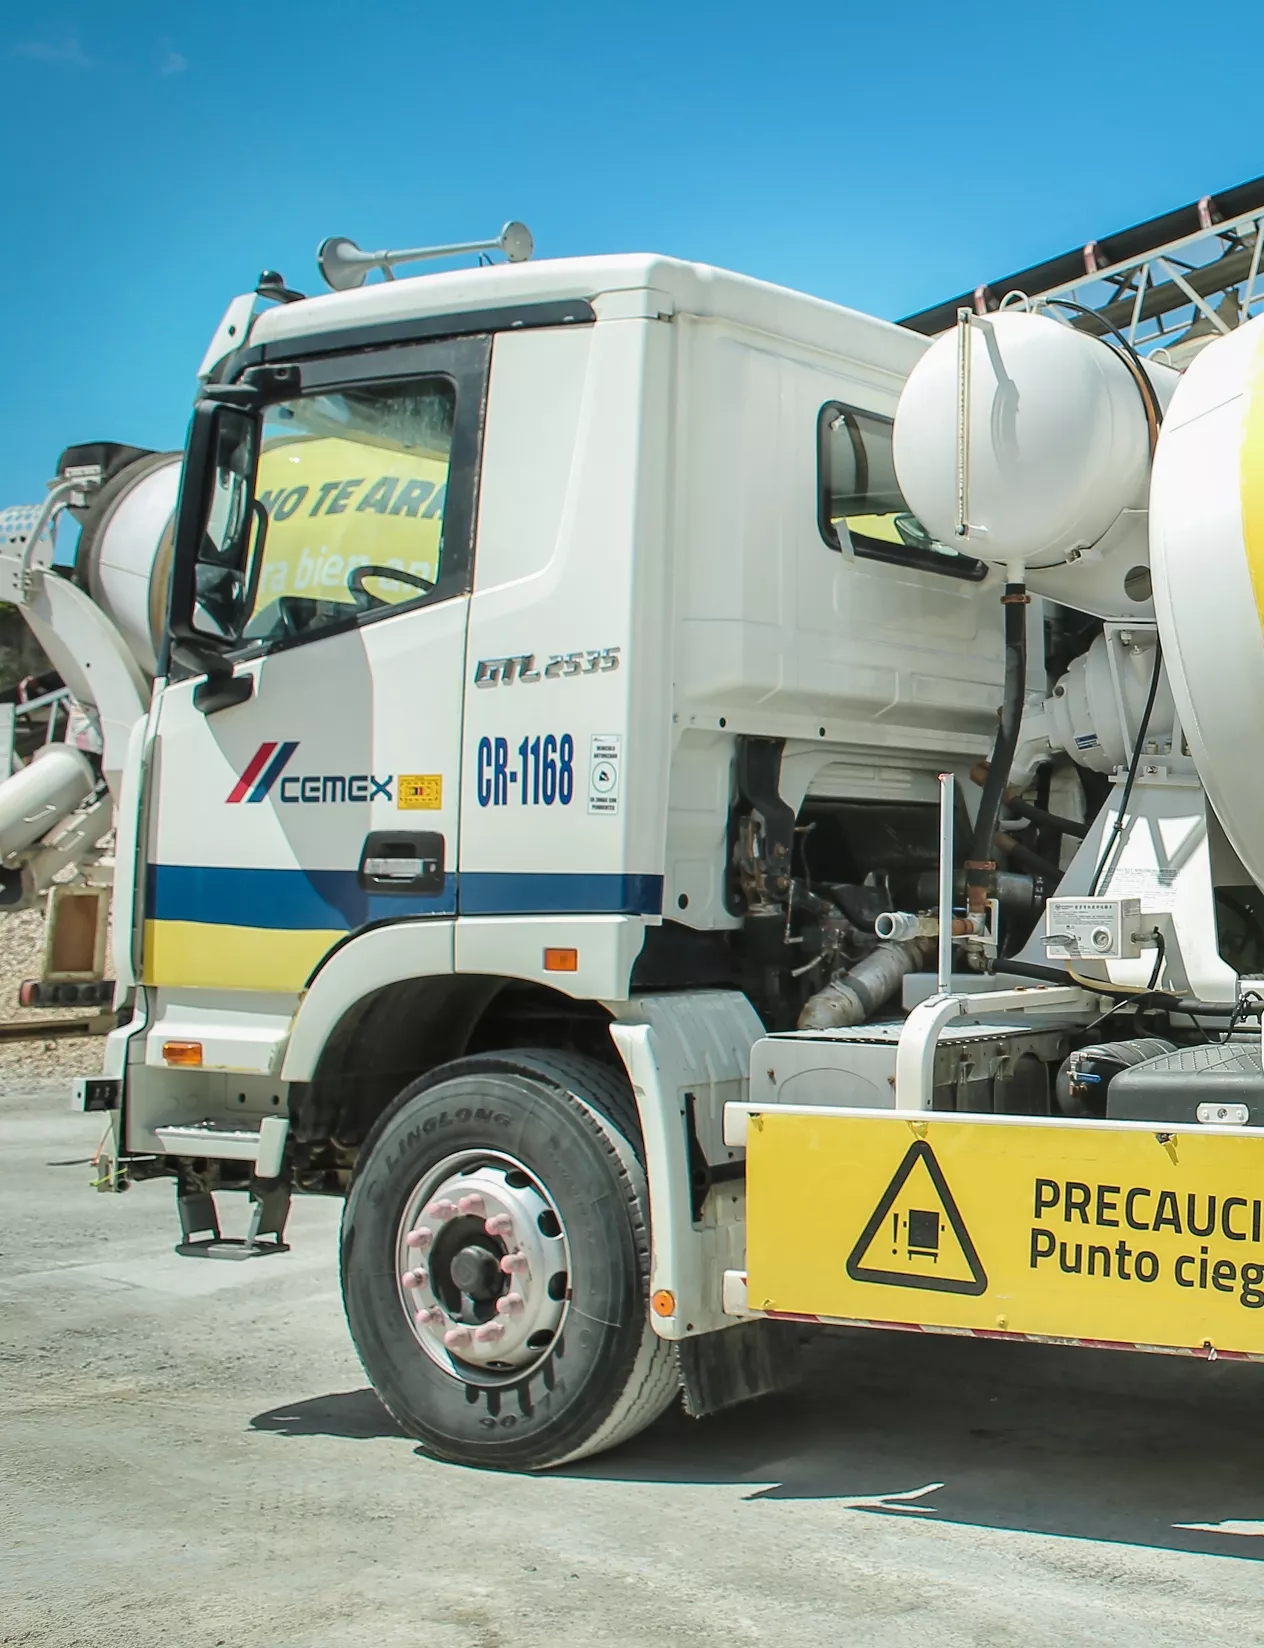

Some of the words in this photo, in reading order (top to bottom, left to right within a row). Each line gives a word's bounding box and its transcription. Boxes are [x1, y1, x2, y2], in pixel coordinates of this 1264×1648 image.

[259, 486, 309, 521] NO
[308, 478, 365, 517] TE
[475, 653, 541, 688] GTL
[545, 647, 621, 679] 2535
[280, 774, 393, 802] CEMEX
[477, 733, 574, 807] CR-1168
[386, 1108, 512, 1174] LINGLONG
[1034, 1178, 1262, 1242] PRECAUCI
[1030, 1228, 1159, 1282] Punto
[1174, 1246, 1264, 1308] cieg
